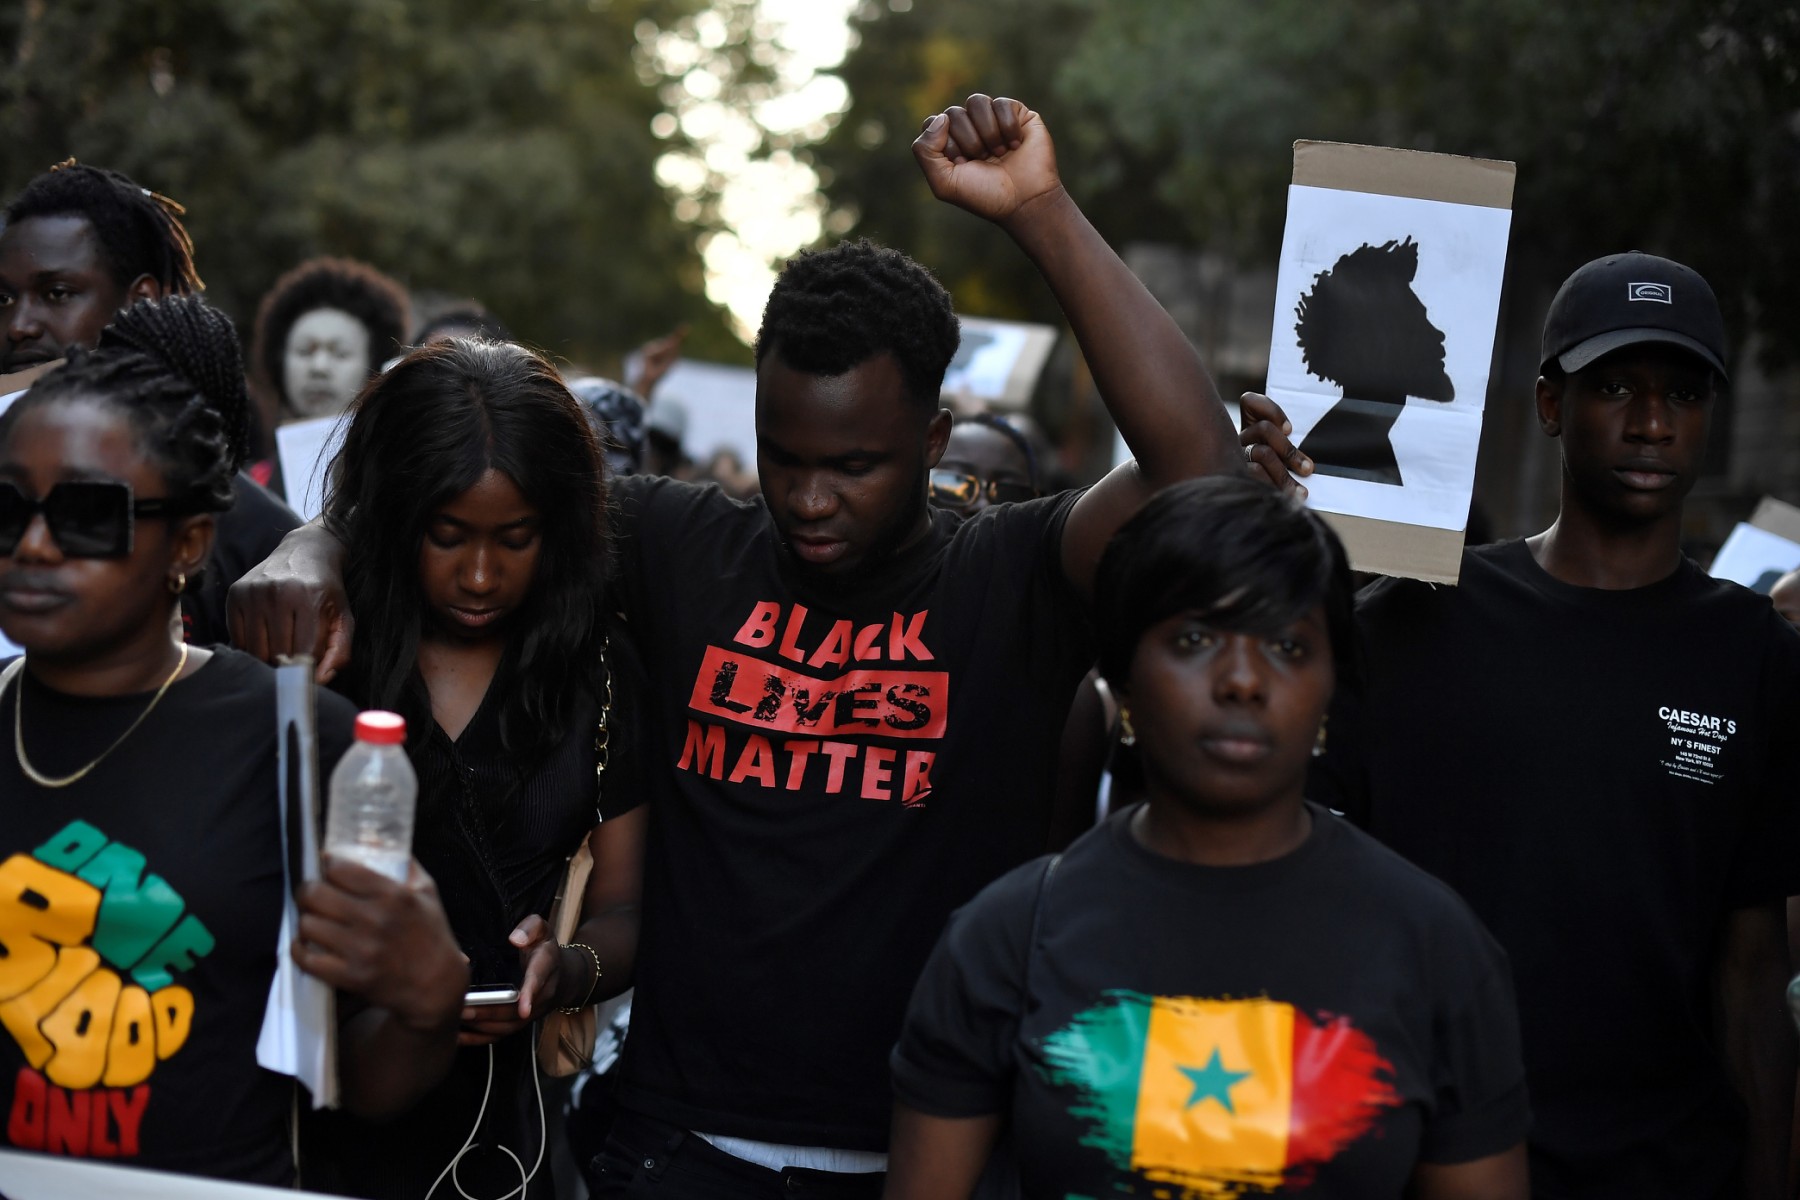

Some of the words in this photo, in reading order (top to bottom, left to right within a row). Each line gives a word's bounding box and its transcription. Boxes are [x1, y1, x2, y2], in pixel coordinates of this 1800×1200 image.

[733, 601, 935, 670] BLACK
[709, 661, 931, 730] LIVES
[676, 719, 936, 804] MATTER
[1667, 721, 1697, 733] Infamous
[1698, 727, 1711, 737] Hot
[1712, 730, 1728, 742] Dogs
[1693, 741, 1721, 755] FINEST
[32, 818, 216, 992] ONE
[7, 1066, 151, 1156] ONLY
